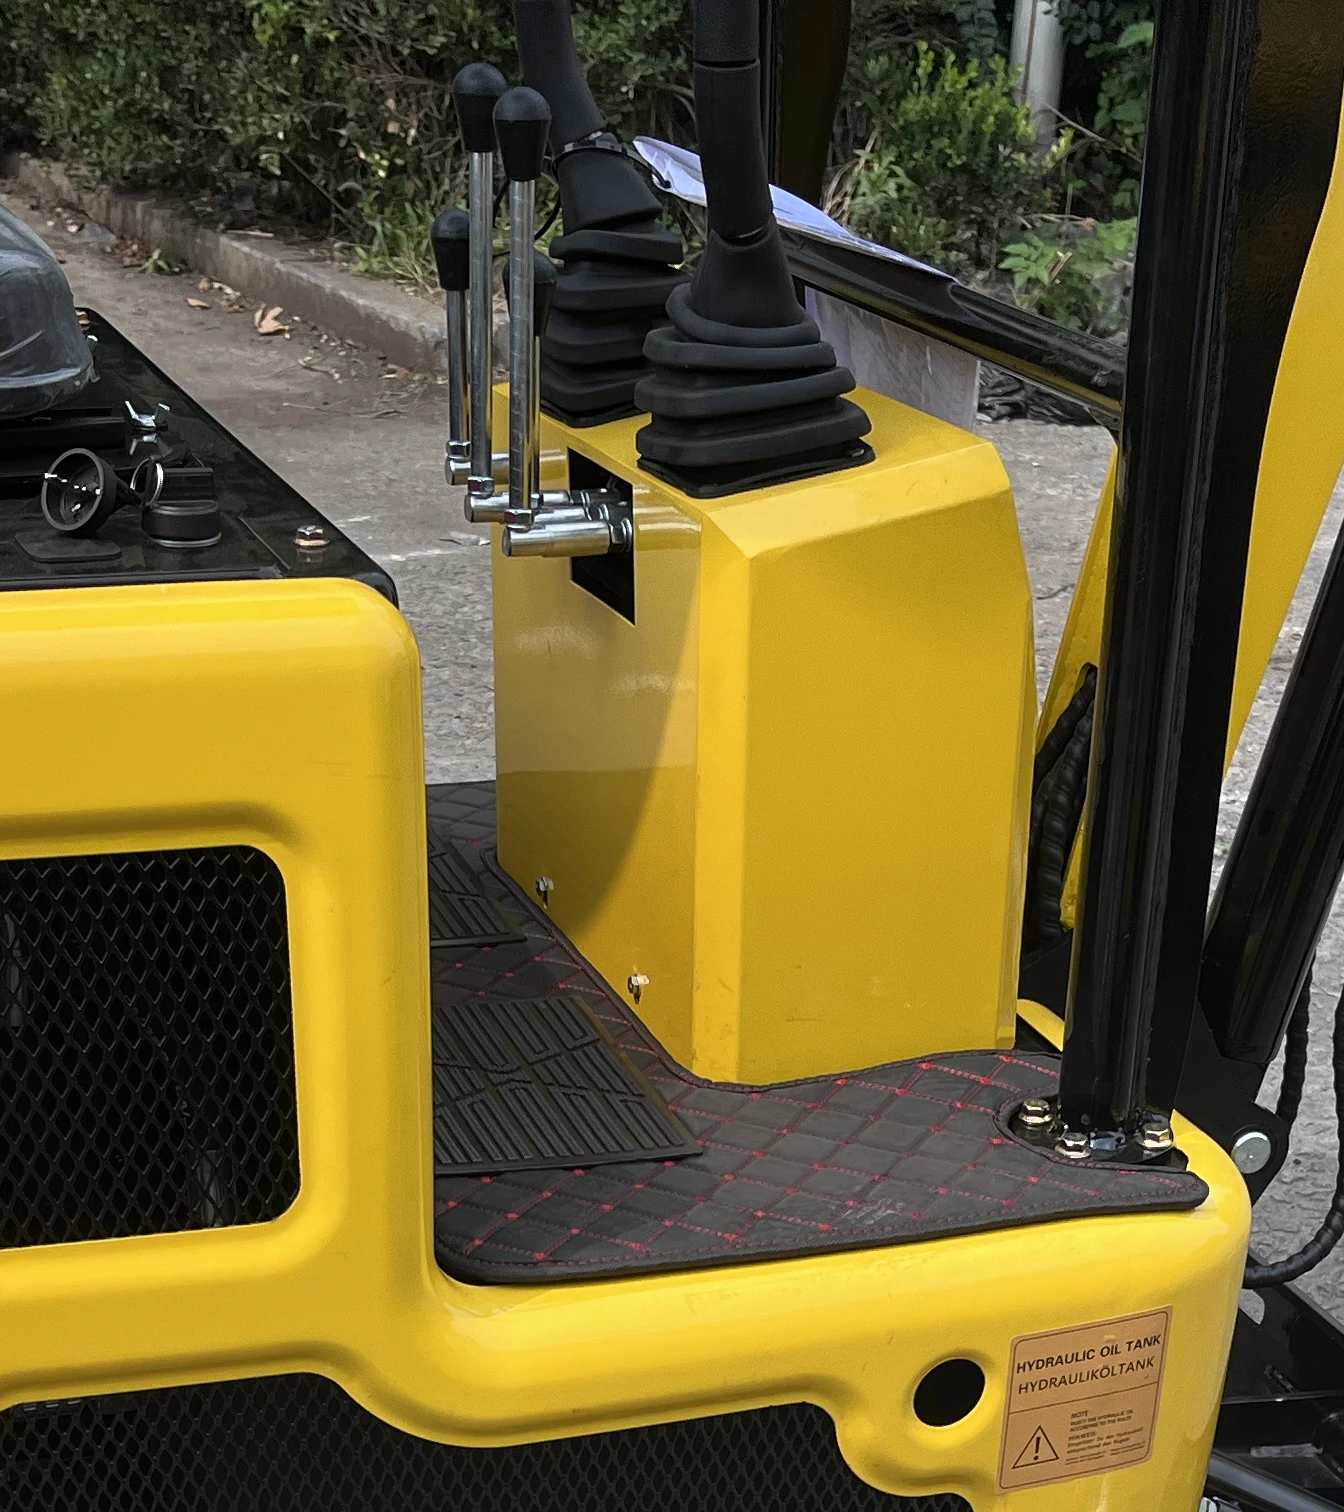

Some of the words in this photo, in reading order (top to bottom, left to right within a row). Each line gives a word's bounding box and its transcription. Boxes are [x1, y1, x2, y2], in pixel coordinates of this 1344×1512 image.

[1016, 1349, 1096, 1374] HYDRAULIC
[1099, 1344, 1121, 1358] OIL
[1126, 1333, 1162, 1352] TANK
[1018, 1355, 1156, 1395] HYDRAULIKÖLTANK
